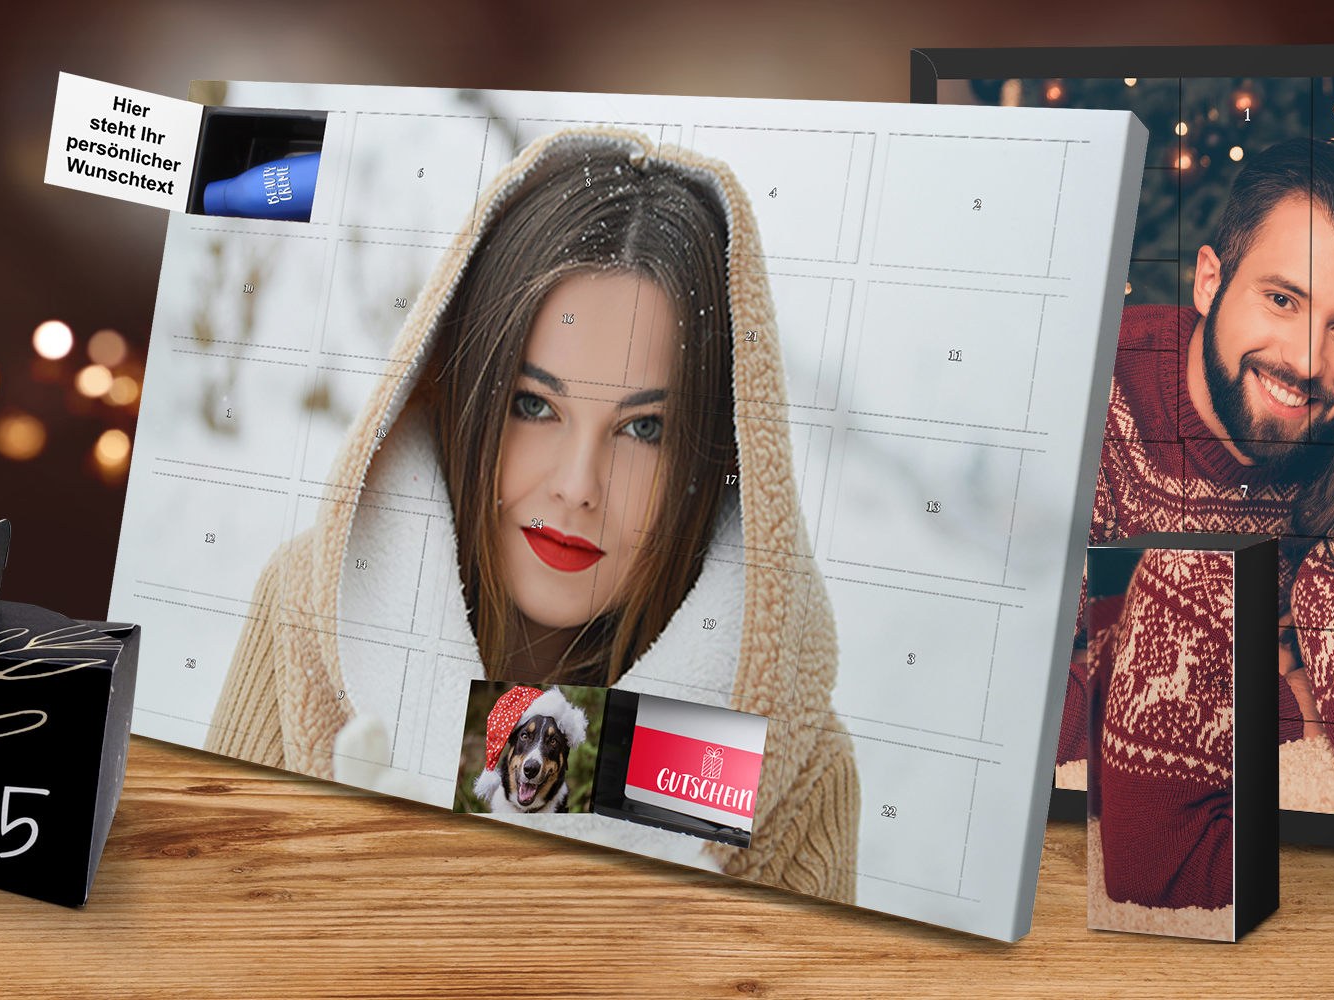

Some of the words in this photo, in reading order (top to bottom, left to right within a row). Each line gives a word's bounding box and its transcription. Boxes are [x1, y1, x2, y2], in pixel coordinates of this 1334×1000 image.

[113, 96, 151, 118] Hier
[1244, 108, 1251, 122] 1
[89, 117, 136, 139] steht
[140, 126, 166, 145] Ihr
[66, 136, 182, 172] persönlicher
[67, 156, 174, 195] Wunschtext
[417, 168, 424, 178] 6
[263, 166, 280, 205] BEAUTY
[277, 165, 294, 201] CREME
[584, 177, 592, 188] 8
[768, 187, 777, 198] 4
[973, 198, 982, 211] 2
[243, 284, 255, 294] 10
[394, 298, 407, 309] 20
[562, 313, 574, 324] 16
[744, 331, 758, 342] 21
[948, 349, 962, 362] 11
[226, 408, 232, 418] 1
[375, 428, 387, 439] 18
[725, 474, 738, 485] 17
[1240, 485, 1249, 498] 7
[926, 501, 941, 513] 13
[531, 519, 544, 530] 24
[204, 533, 216, 544] 12
[356, 559, 367, 570] 14
[702, 619, 716, 630] 19
[184, 658, 196, 669] 23
[907, 653, 915, 665] 3
[337, 690, 345, 700] 9
[656, 767, 753, 812] GUTSCHEIN
[881, 804, 897, 818] 22
[0, 786, 50, 858] 5
